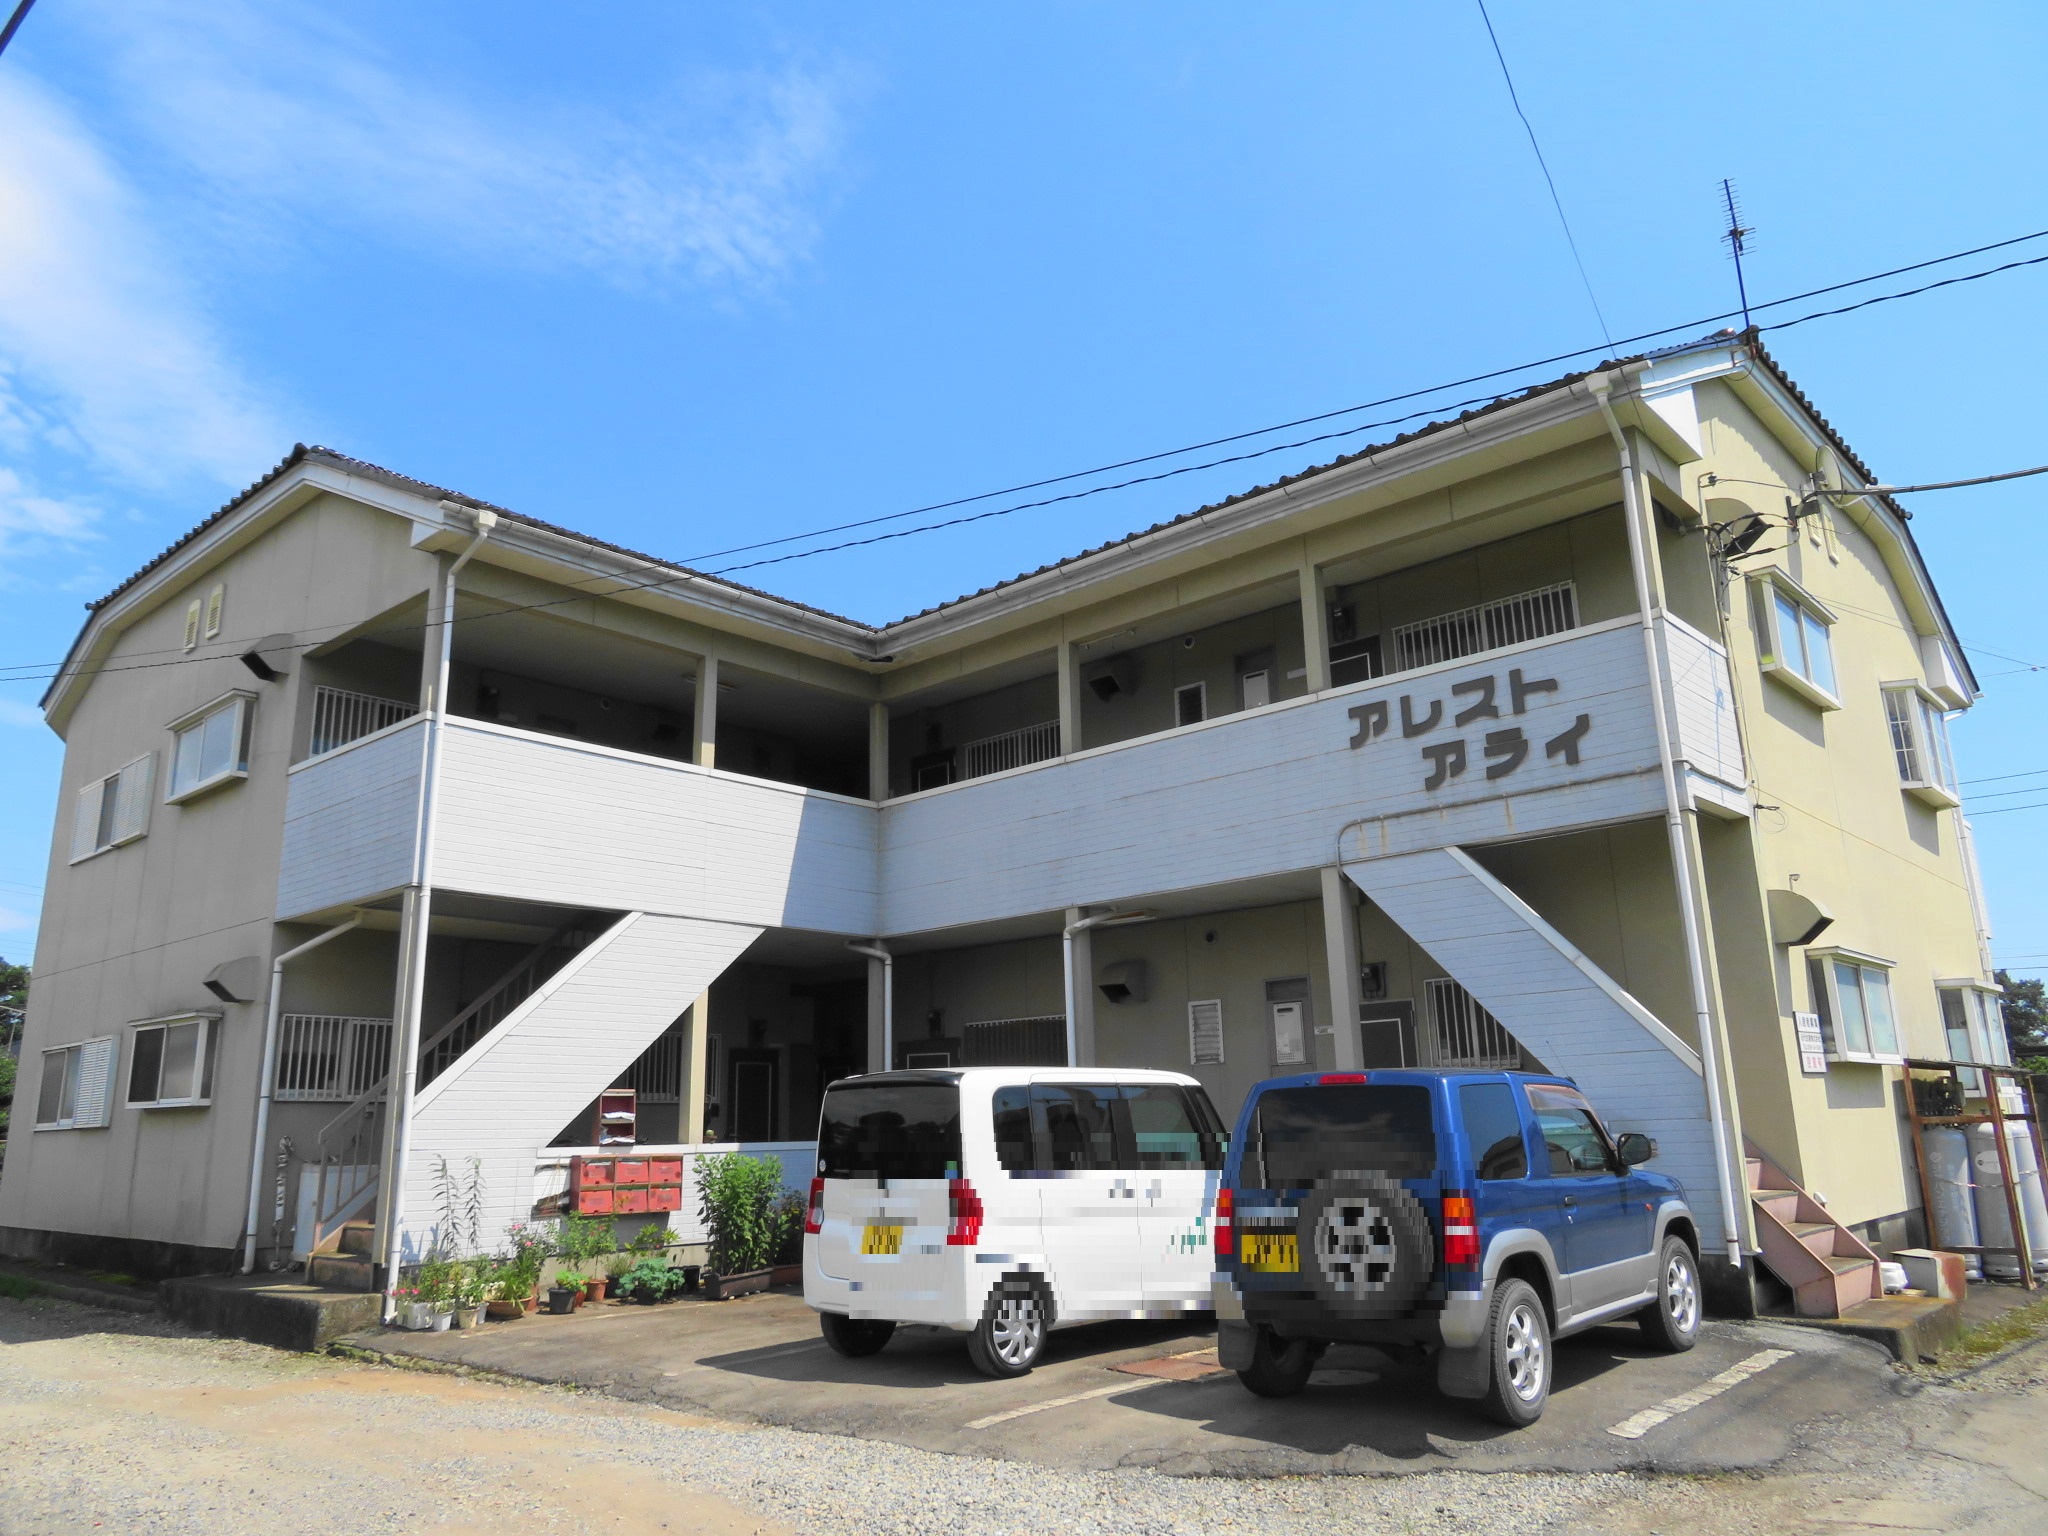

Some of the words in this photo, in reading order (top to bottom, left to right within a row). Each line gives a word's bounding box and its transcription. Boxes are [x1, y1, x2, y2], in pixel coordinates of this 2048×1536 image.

[1348, 668, 1559, 750] アレスト
[1422, 713, 1590, 791] アライ
